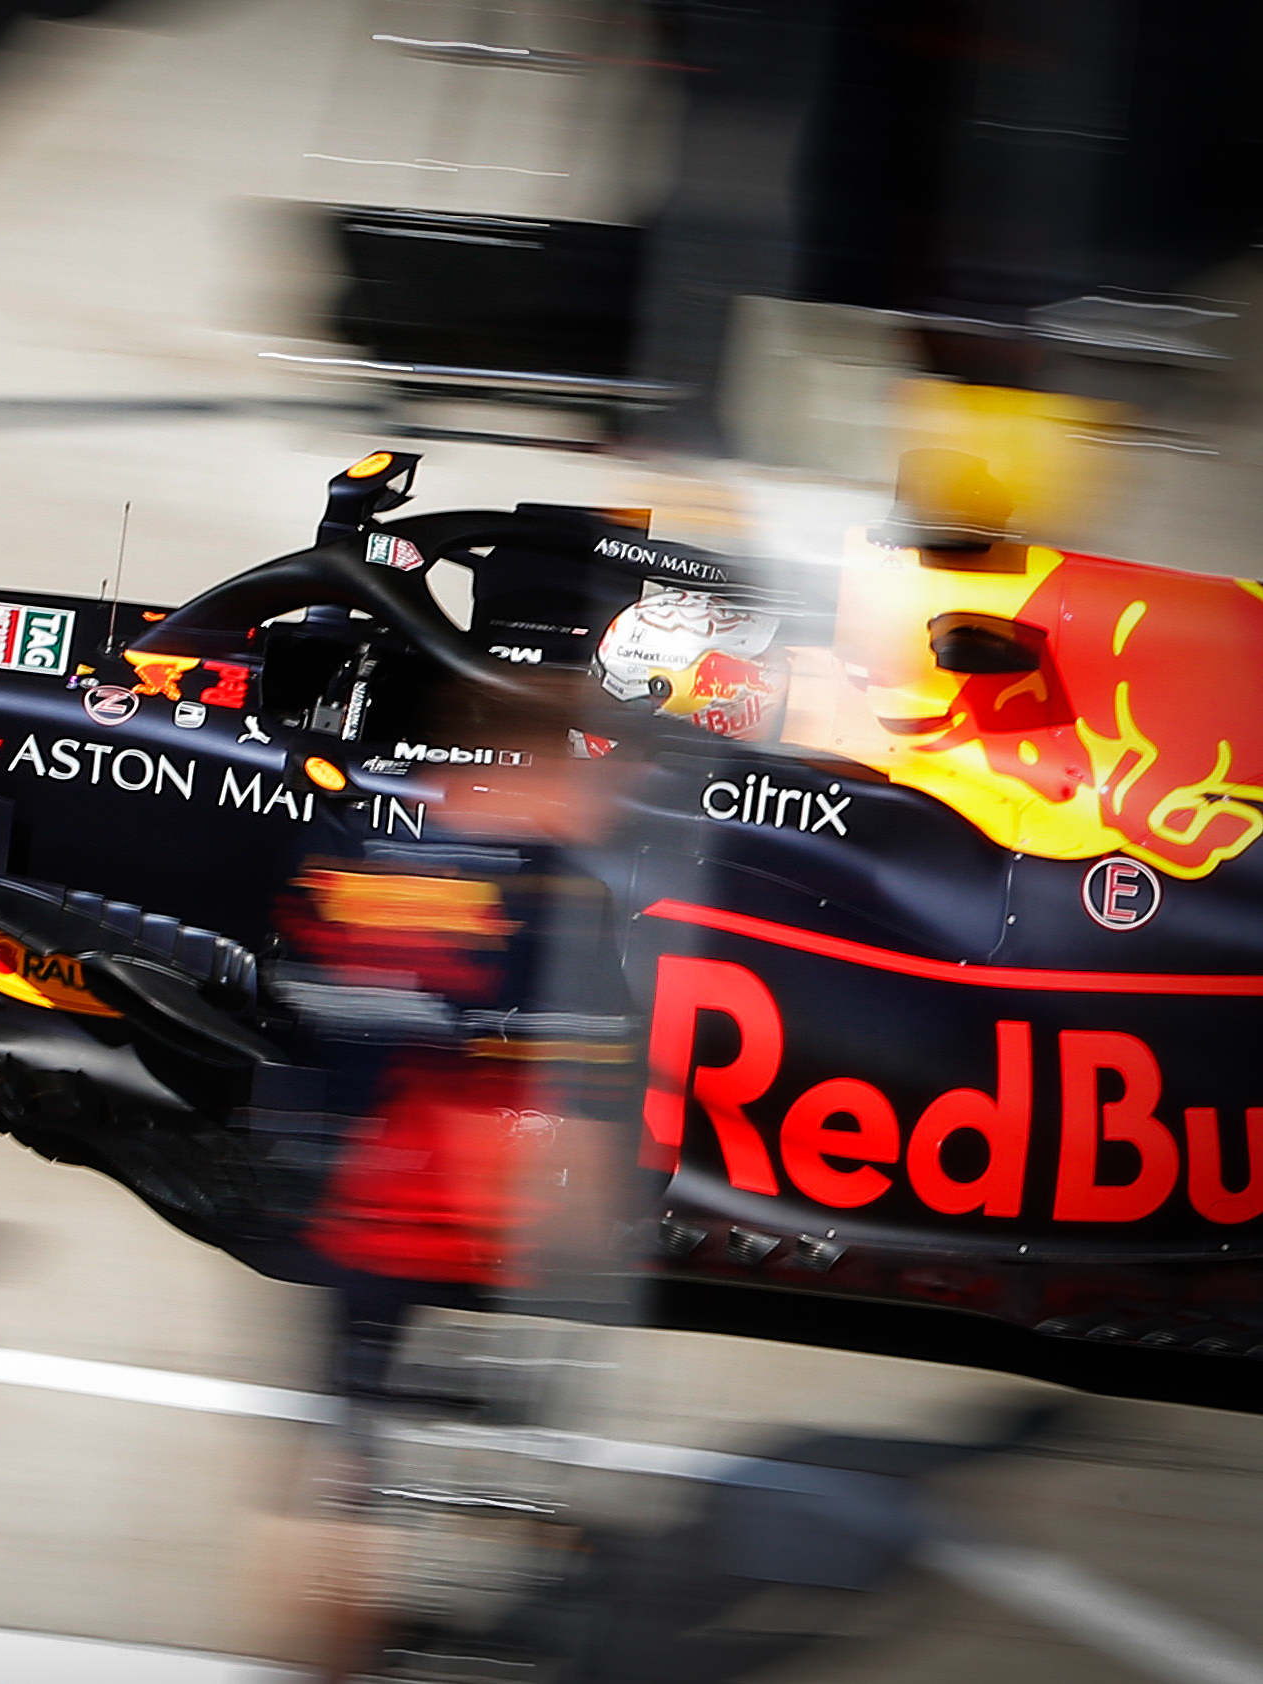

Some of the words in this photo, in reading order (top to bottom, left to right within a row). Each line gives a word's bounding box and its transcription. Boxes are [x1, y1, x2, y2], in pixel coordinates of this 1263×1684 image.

[594, 538, 657, 565] ASTON
[660, 555, 729, 582] MARTIN
[25, 613, 62, 669] TAG
[617, 645, 689, 663] CarNext.com
[393, 742, 494, 765] Mobil
[8, 734, 196, 800] ASTON
[218, 766, 425, 840] MAIN
[703, 773, 852, 836] citrix
[638, 955, 1032, 1218] Red
